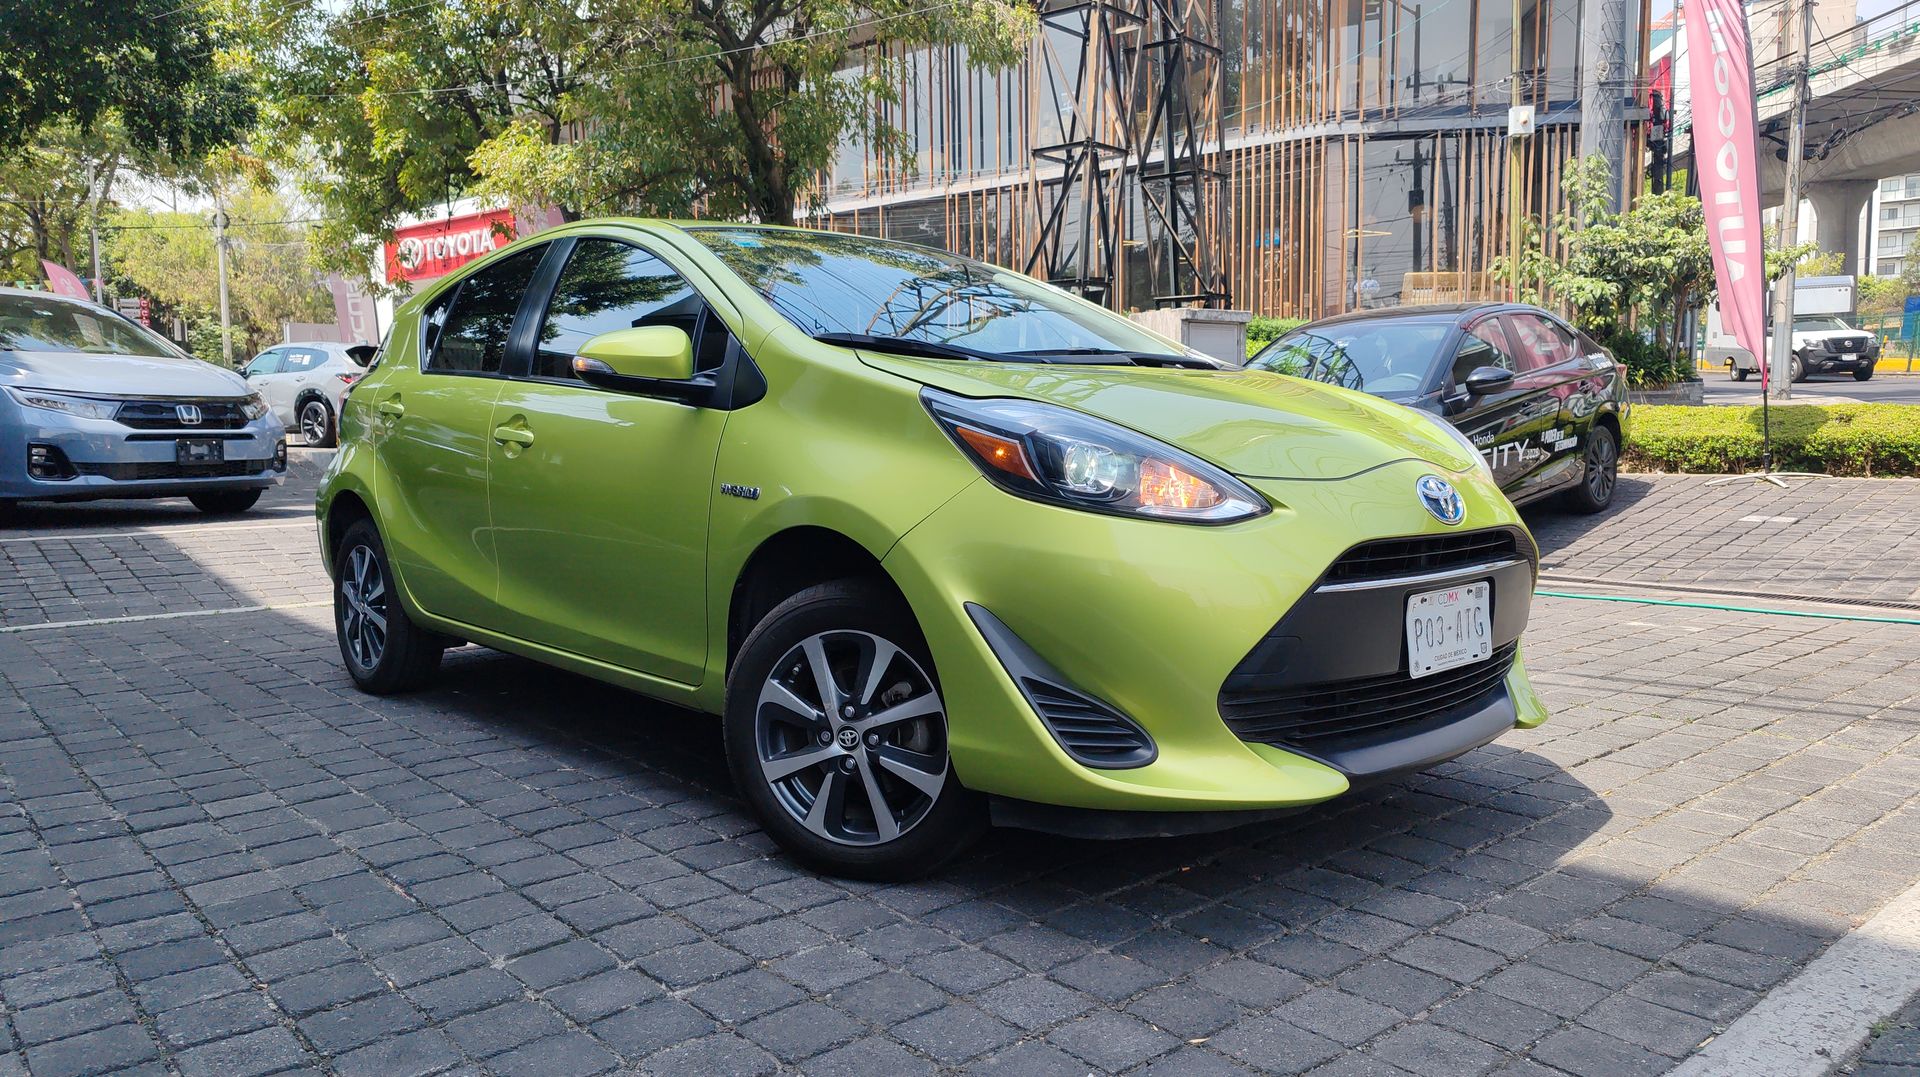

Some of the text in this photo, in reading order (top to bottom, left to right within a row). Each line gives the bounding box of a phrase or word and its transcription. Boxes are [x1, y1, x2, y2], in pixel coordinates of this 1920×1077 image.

[424, 228, 496, 260] TOYOTA
[1473, 431, 1495, 446] Honda
[1438, 592, 1459, 605] CDMX
